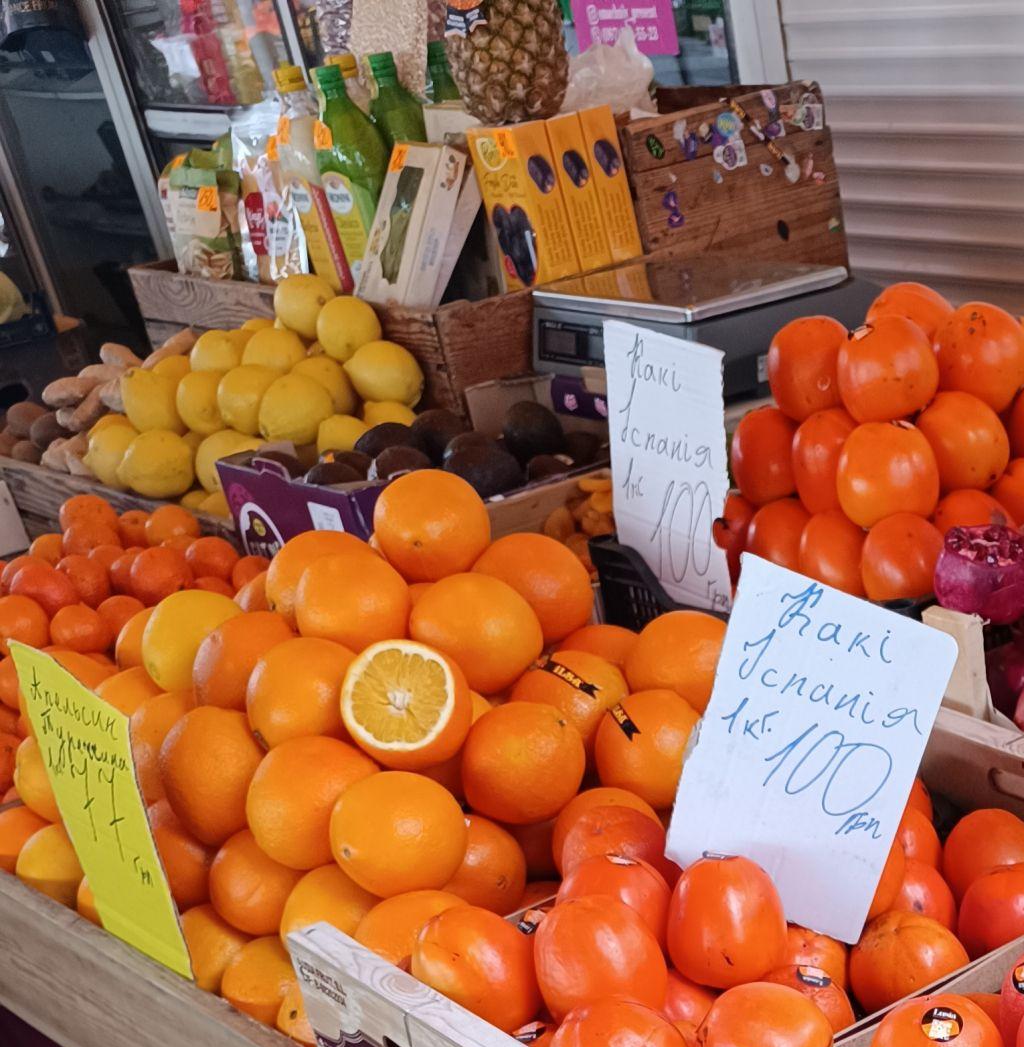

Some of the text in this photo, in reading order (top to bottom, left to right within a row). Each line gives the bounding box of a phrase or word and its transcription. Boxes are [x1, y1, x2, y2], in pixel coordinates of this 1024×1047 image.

[650, 480, 713, 584] 100
[777, 582, 893, 664] Какі
[737, 628, 923, 736] Іспанія
[762, 722, 894, 818] 100
